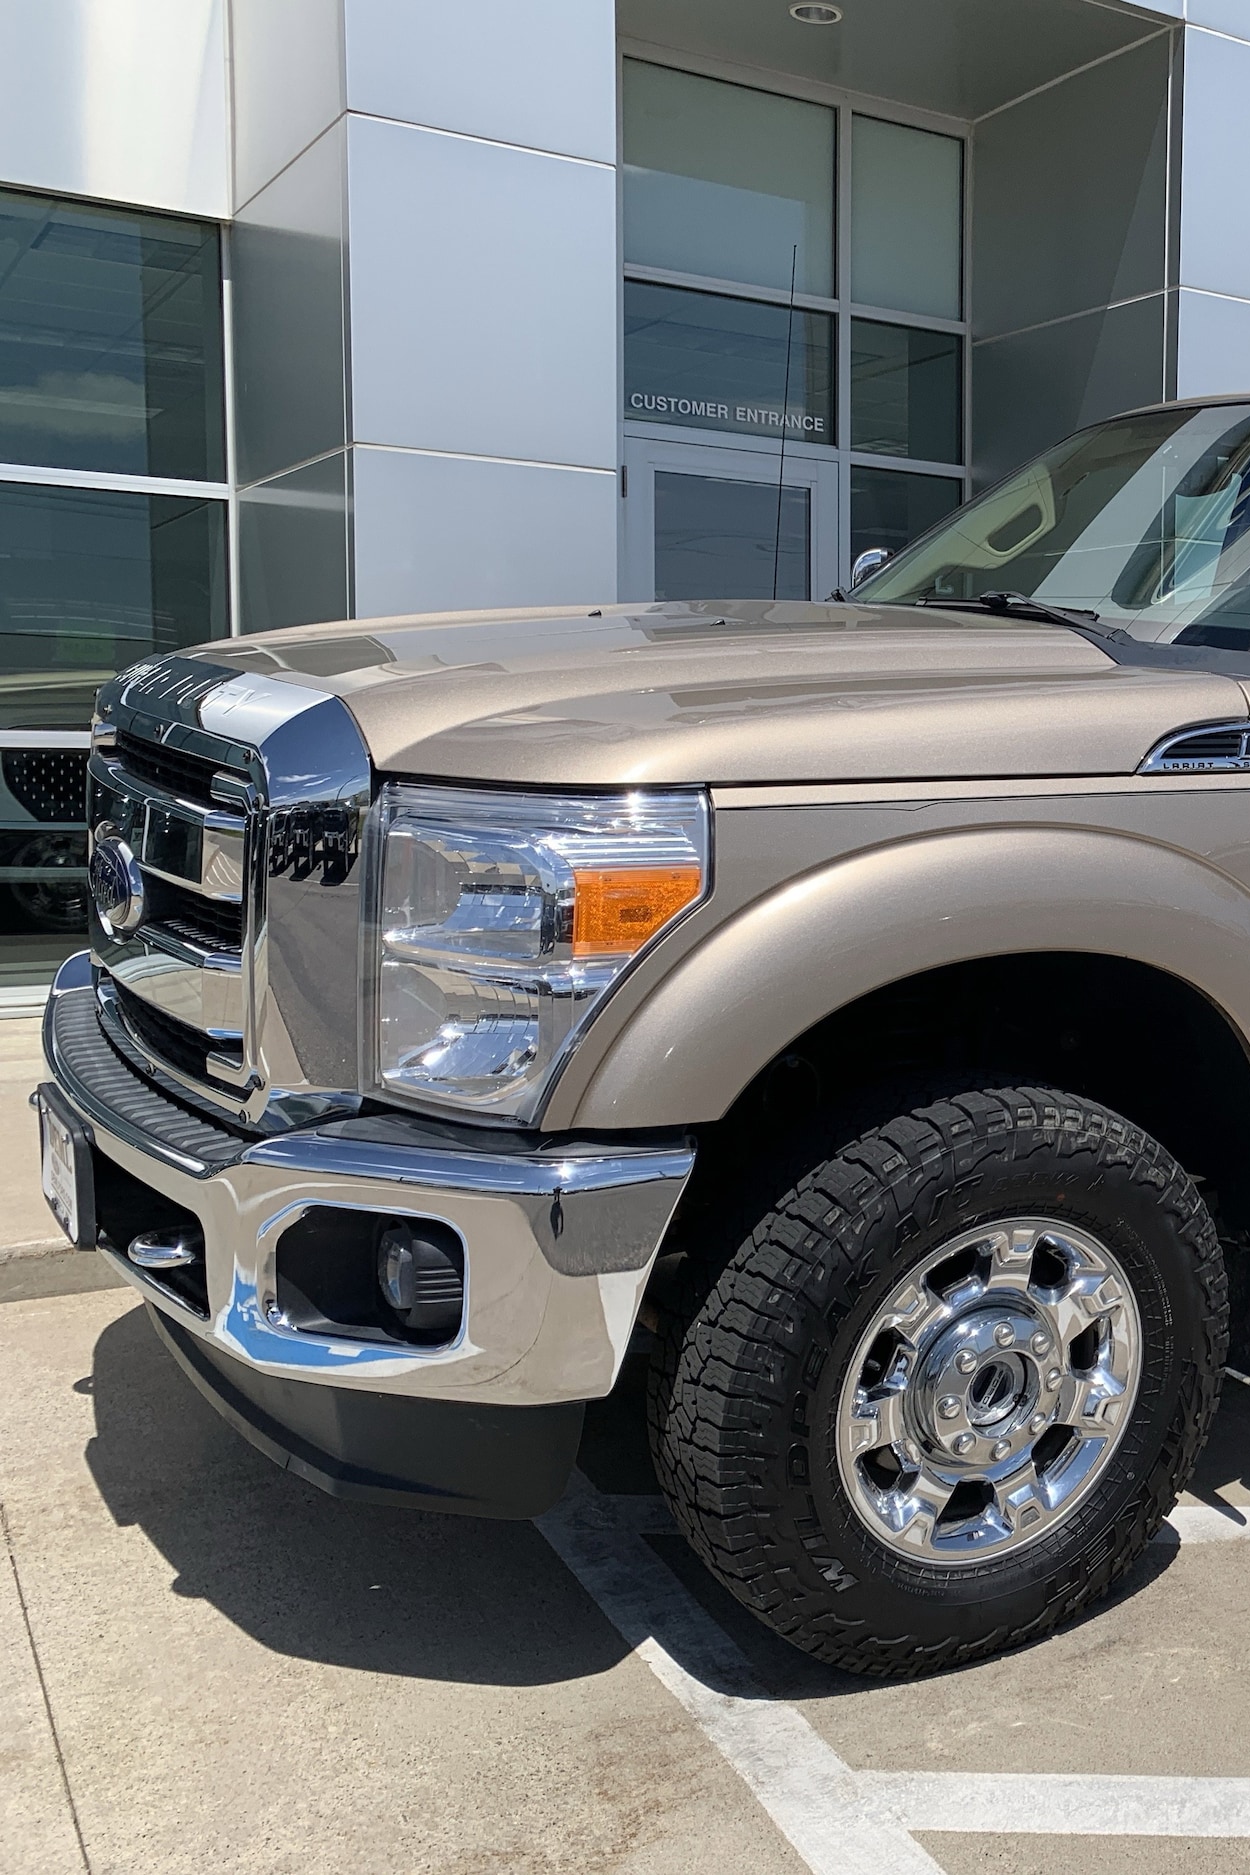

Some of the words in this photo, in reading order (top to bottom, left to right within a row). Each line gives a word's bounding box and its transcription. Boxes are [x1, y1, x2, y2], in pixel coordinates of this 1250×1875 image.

[630, 393, 728, 419] CUSTOMER
[736, 407, 825, 432] ENTRANCE
[1163, 762, 1215, 770] LARIAT
